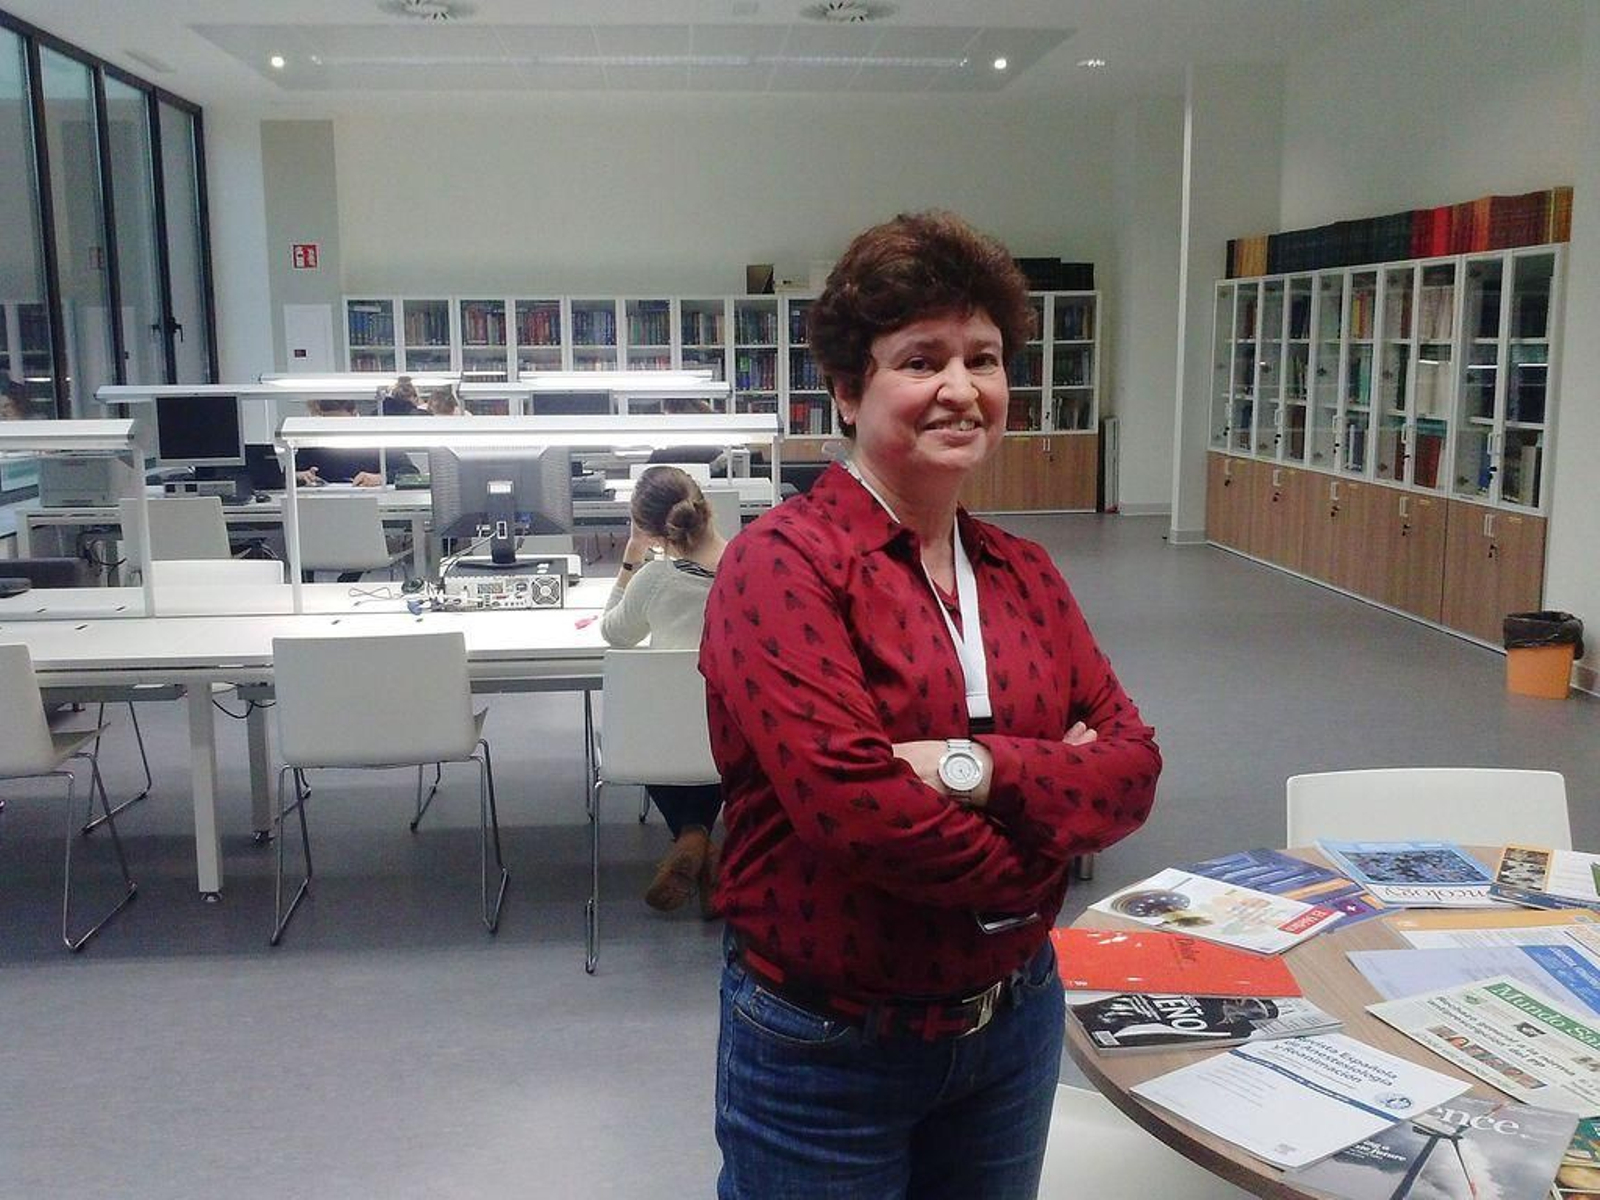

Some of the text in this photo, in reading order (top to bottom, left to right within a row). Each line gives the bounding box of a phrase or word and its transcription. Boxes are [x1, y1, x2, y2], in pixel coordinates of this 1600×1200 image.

[1384, 886, 1485, 901] ncology
[1153, 998, 1209, 1031] ENO
[1493, 985, 1566, 1030] Mundo
[1338, 1050, 1398, 1079] Española
